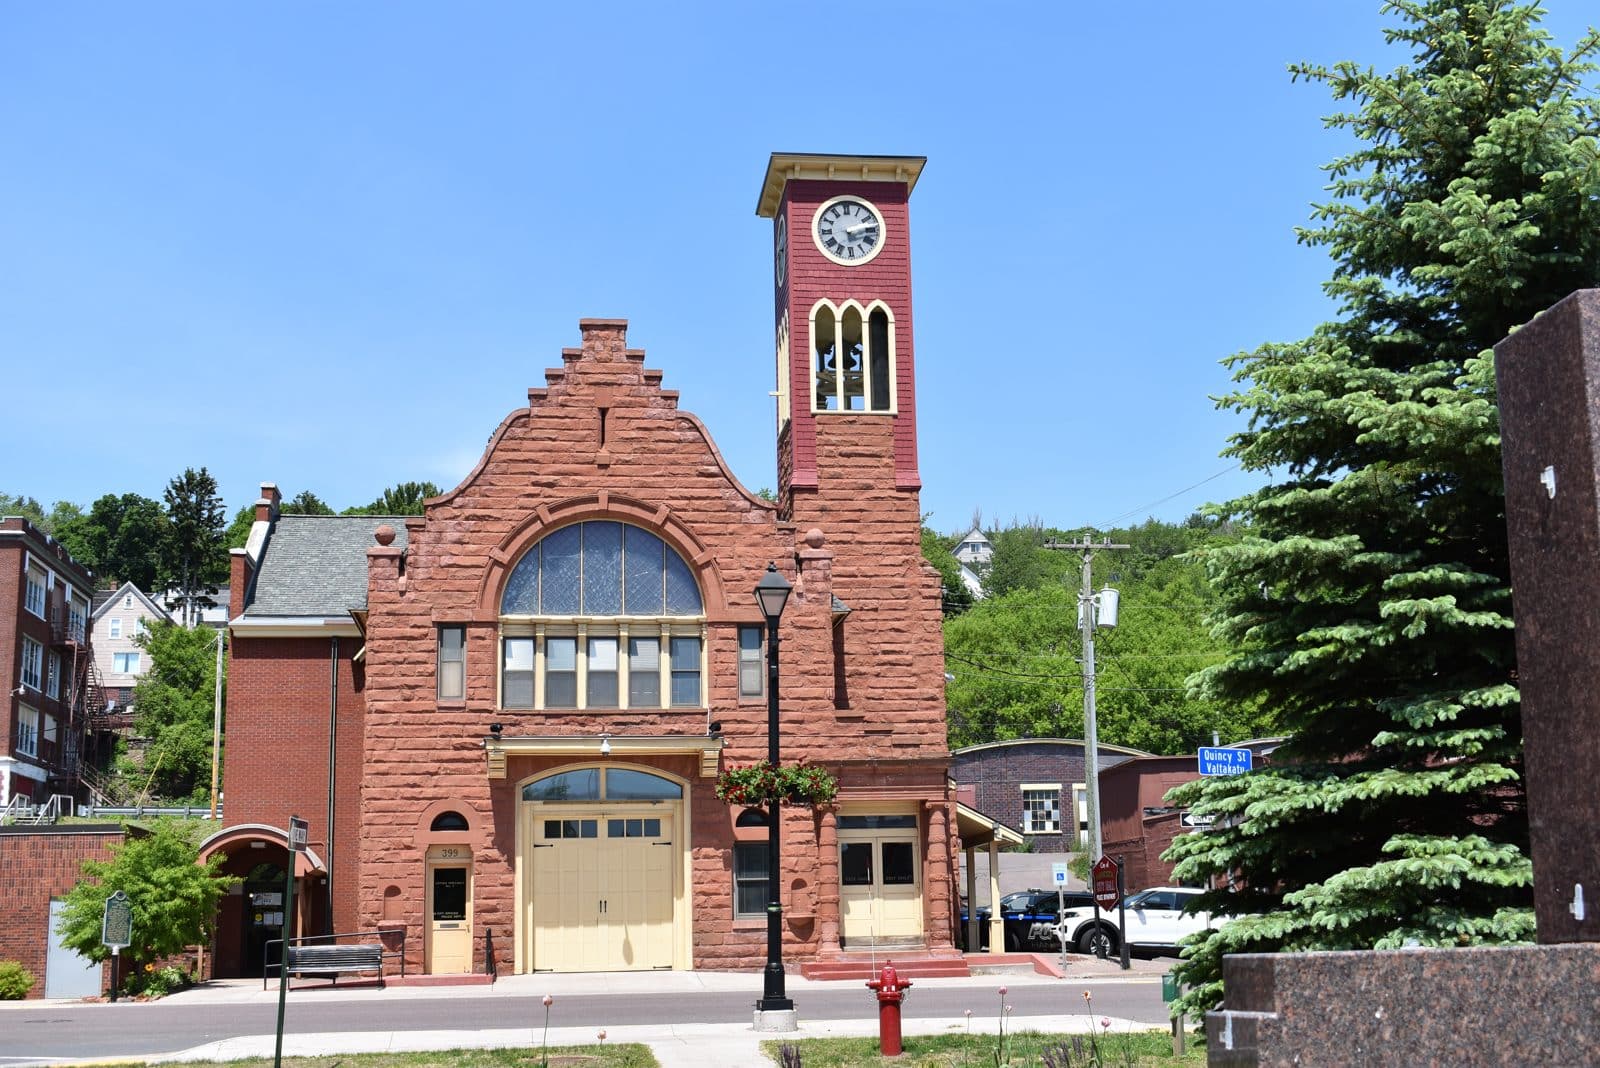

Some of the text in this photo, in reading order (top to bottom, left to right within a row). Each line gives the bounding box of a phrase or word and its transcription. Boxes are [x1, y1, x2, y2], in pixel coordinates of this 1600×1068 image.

[1204, 750, 1246, 763] Quincy St
[441, 848, 459, 858] 399
